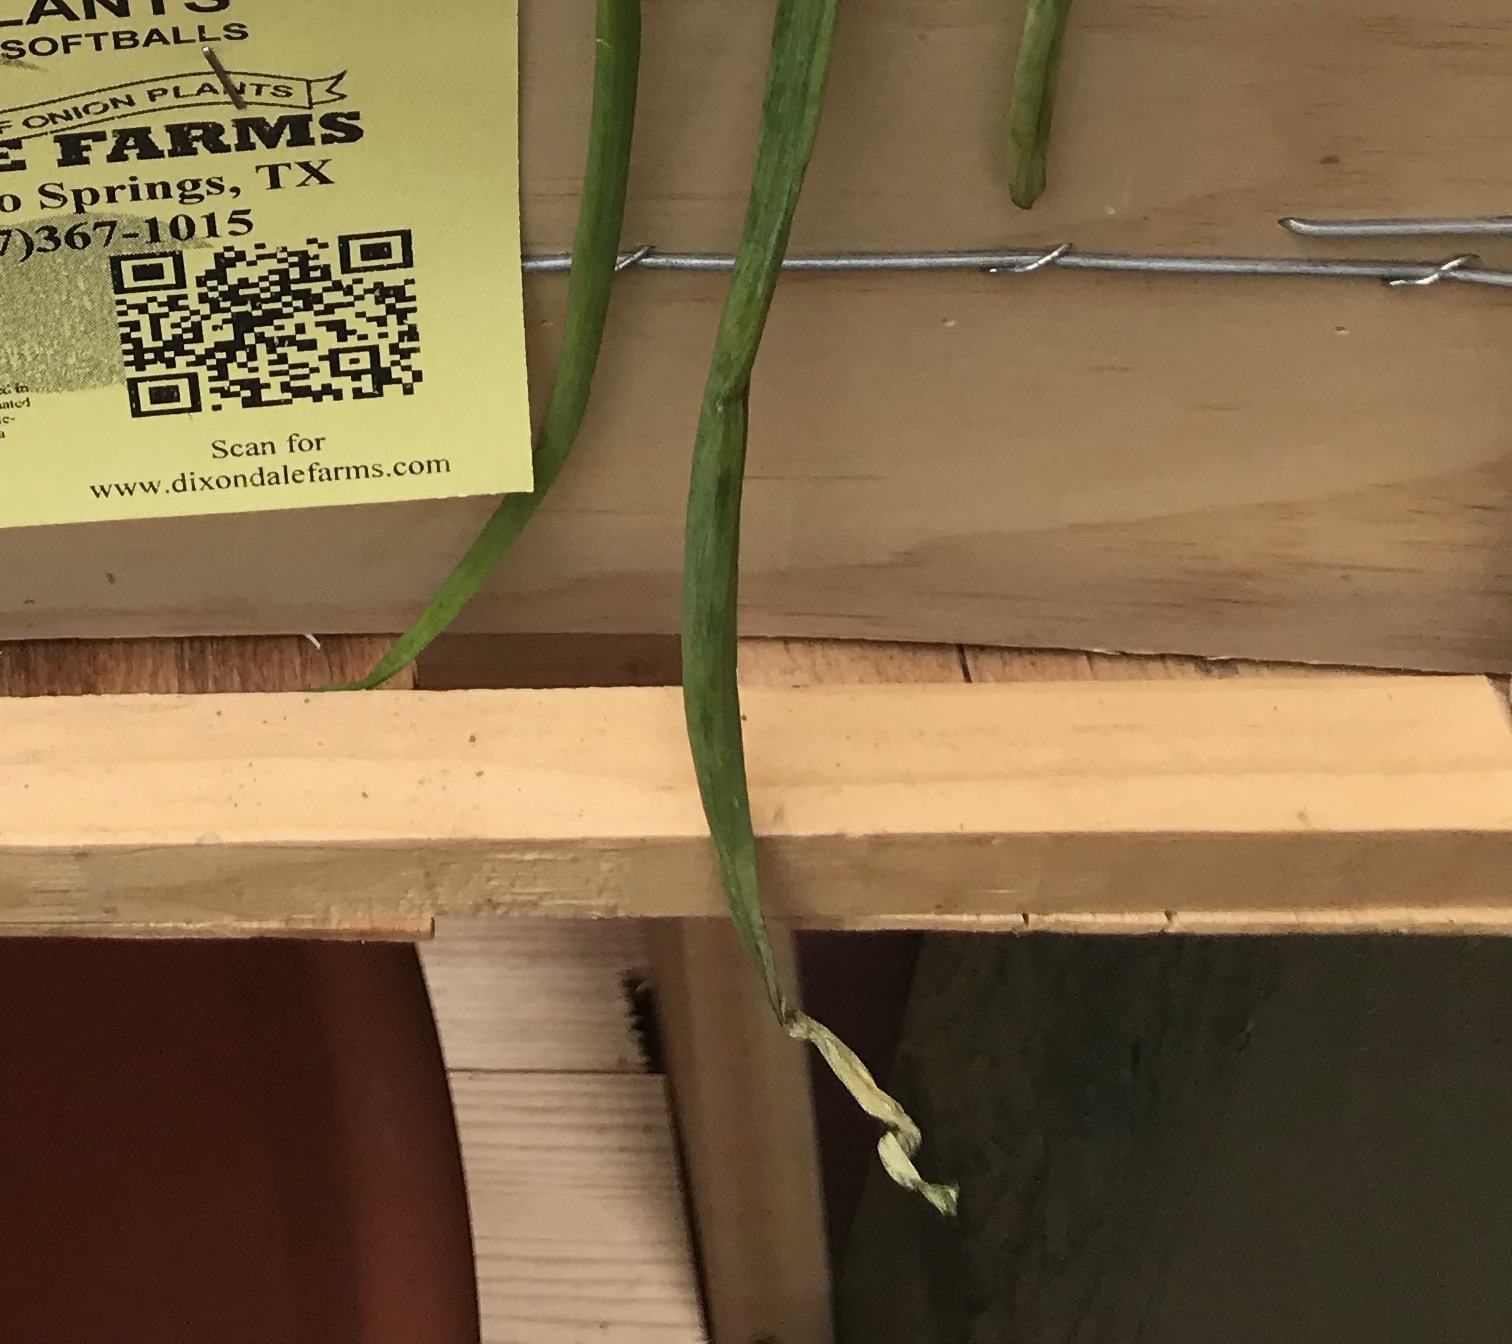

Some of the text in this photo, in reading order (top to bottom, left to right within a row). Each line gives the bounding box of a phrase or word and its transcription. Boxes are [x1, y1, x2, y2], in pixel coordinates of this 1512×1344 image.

[0, 21, 250, 61] SOFTBALLS
[22, 92, 136, 130] ONION
[146, 80, 294, 103] PLANTS
[54, 110, 365, 169] FARMS
[39, 174, 241, 215] Springs,
[255, 158, 336, 191] TX
[211, 432, 327, 460] Scan for
[89, 455, 452, 499] www.dixondalefarms.com
